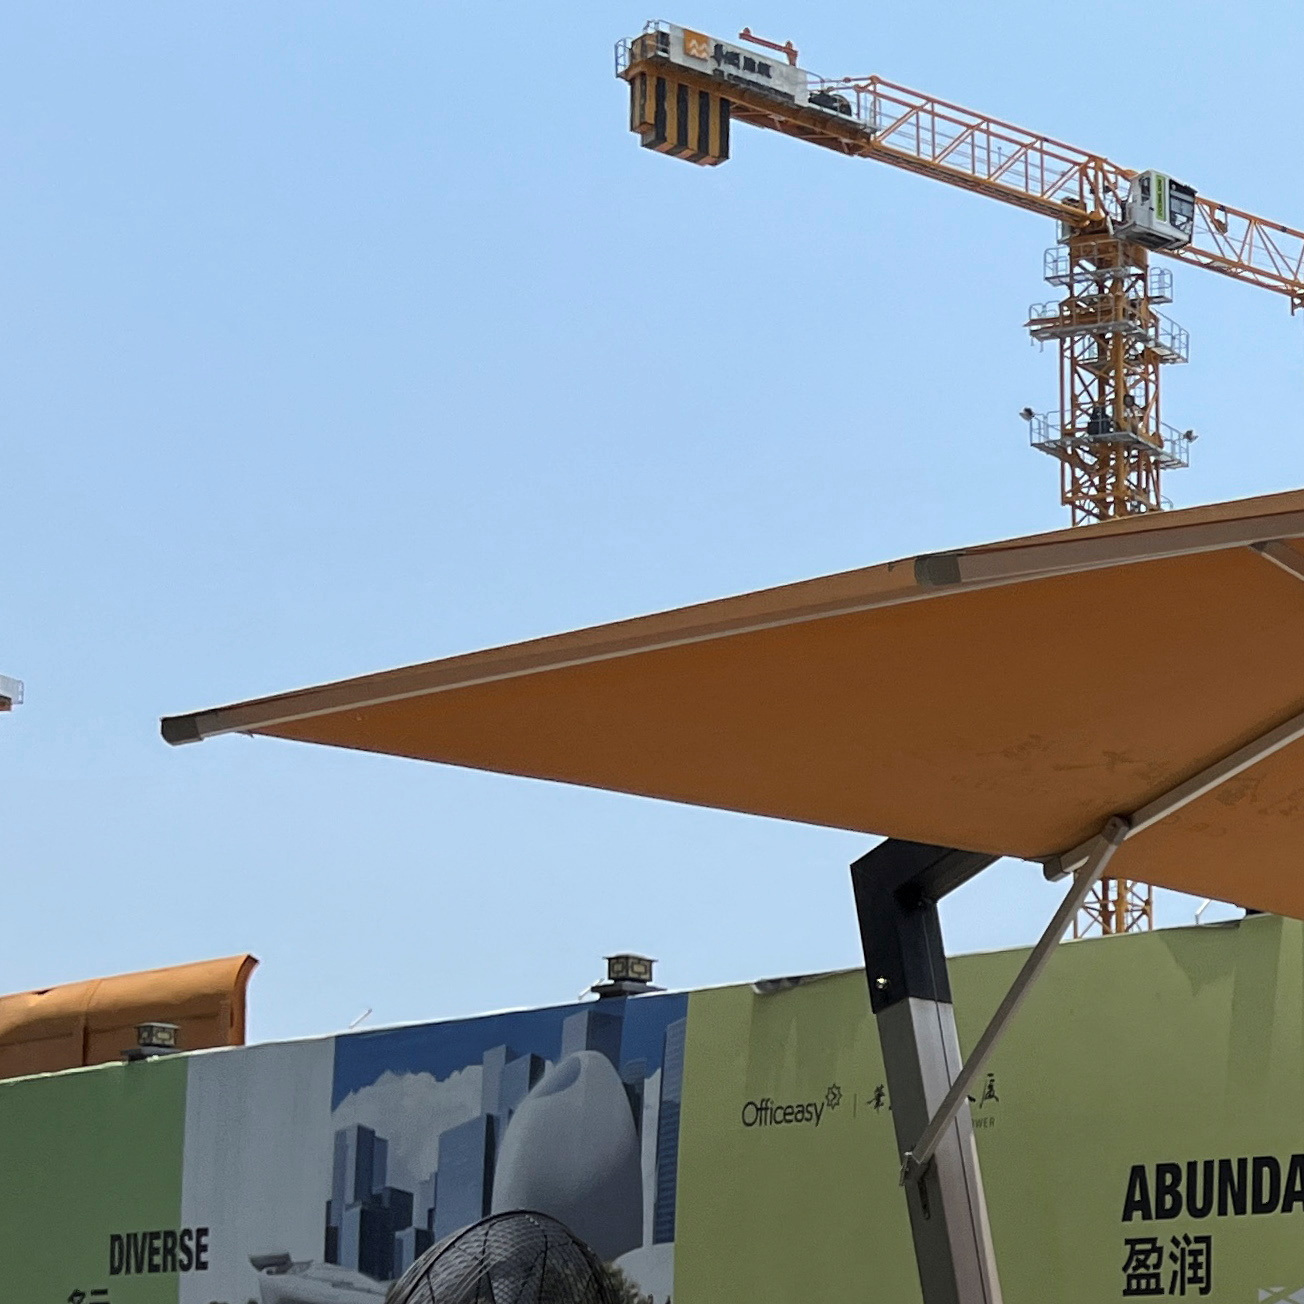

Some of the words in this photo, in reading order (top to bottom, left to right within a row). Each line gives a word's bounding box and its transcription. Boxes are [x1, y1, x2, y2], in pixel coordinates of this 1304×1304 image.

[741, 1097, 825, 1127] Officeasy
[110, 1228, 208, 1275] DIVERSE
[1122, 1232, 1213, 1297] 盈润
